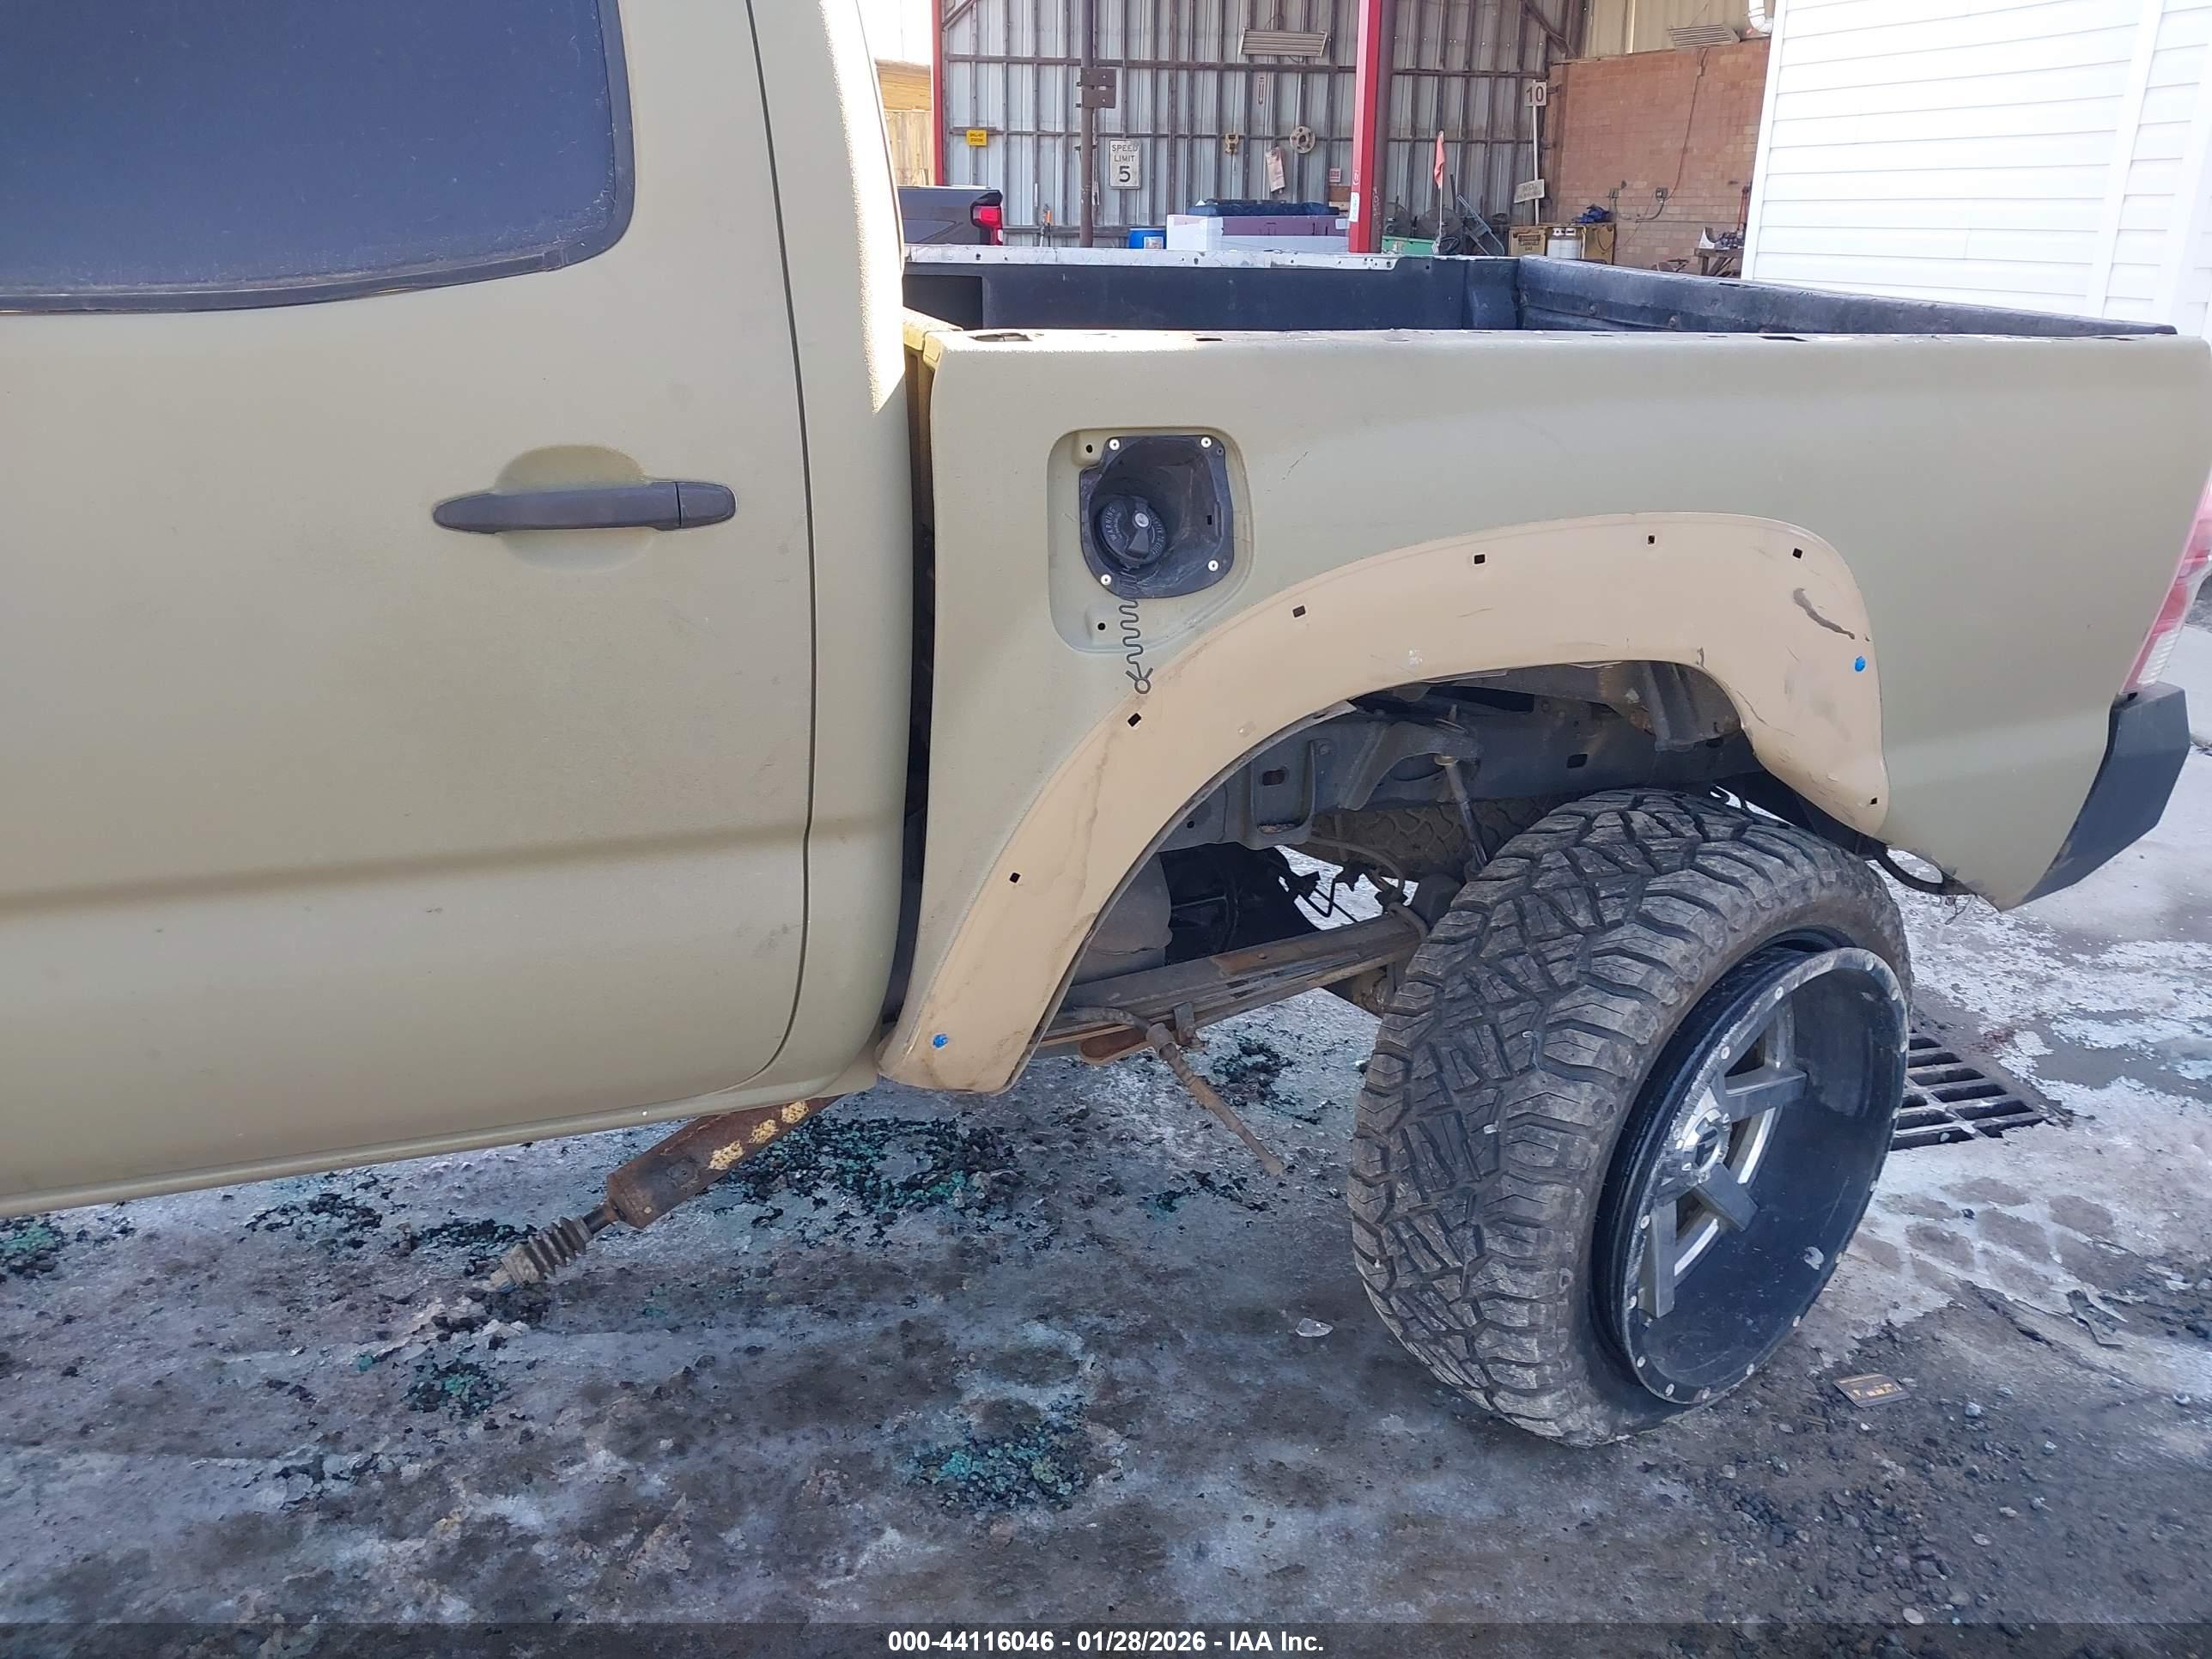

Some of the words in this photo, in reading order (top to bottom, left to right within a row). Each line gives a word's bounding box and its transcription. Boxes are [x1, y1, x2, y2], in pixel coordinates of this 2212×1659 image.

[1526, 86, 1544, 103] 10
[1119, 165, 1131, 183] 5
[1105, 506, 1117, 542] WARNING
